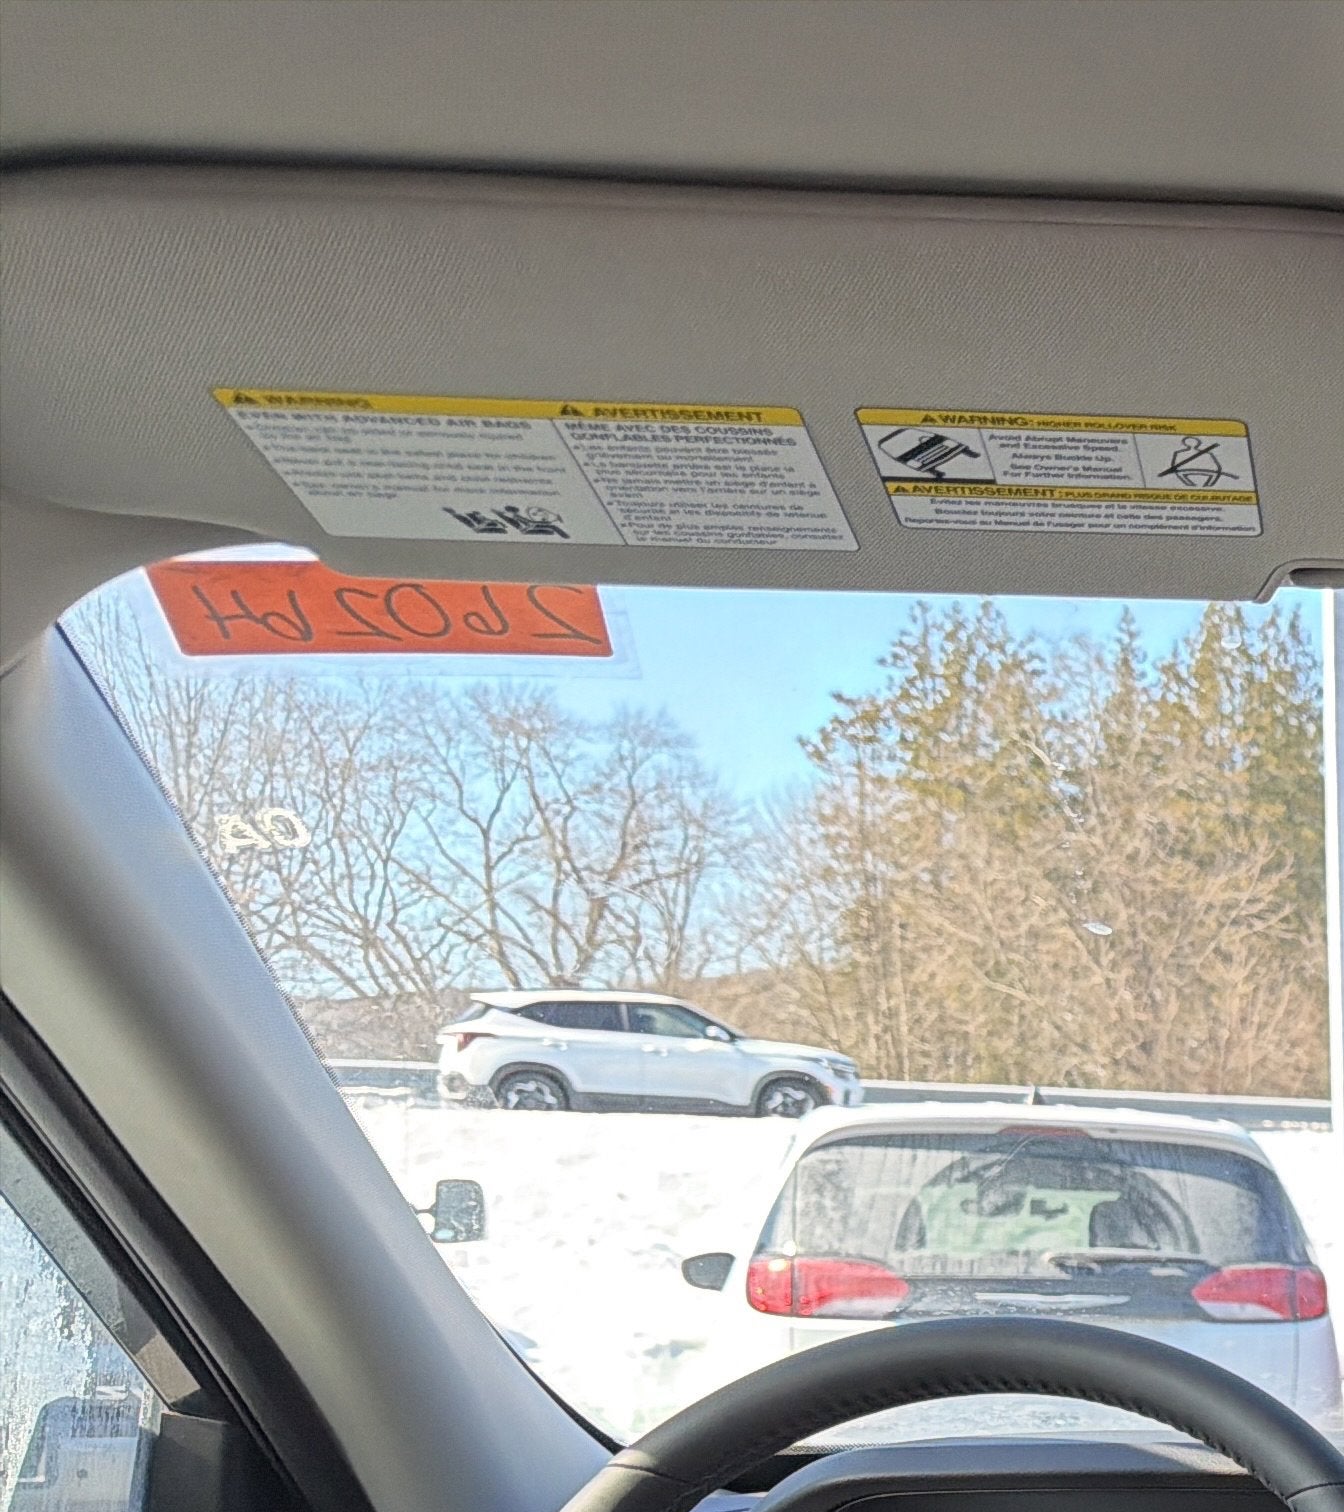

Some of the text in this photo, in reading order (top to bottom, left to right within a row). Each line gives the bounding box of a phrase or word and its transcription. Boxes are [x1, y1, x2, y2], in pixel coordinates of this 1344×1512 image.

[594, 408, 762, 422] AVERTISSEMENT
[616, 424, 651, 434] AVEC
[660, 425, 690, 435] DES
[694, 426, 773, 436] COUSSINS
[1150, 423, 1177, 432] RISK
[570, 432, 672, 444] GONFLABLES
[912, 485, 1055, 497] AVERTISSEMENT
